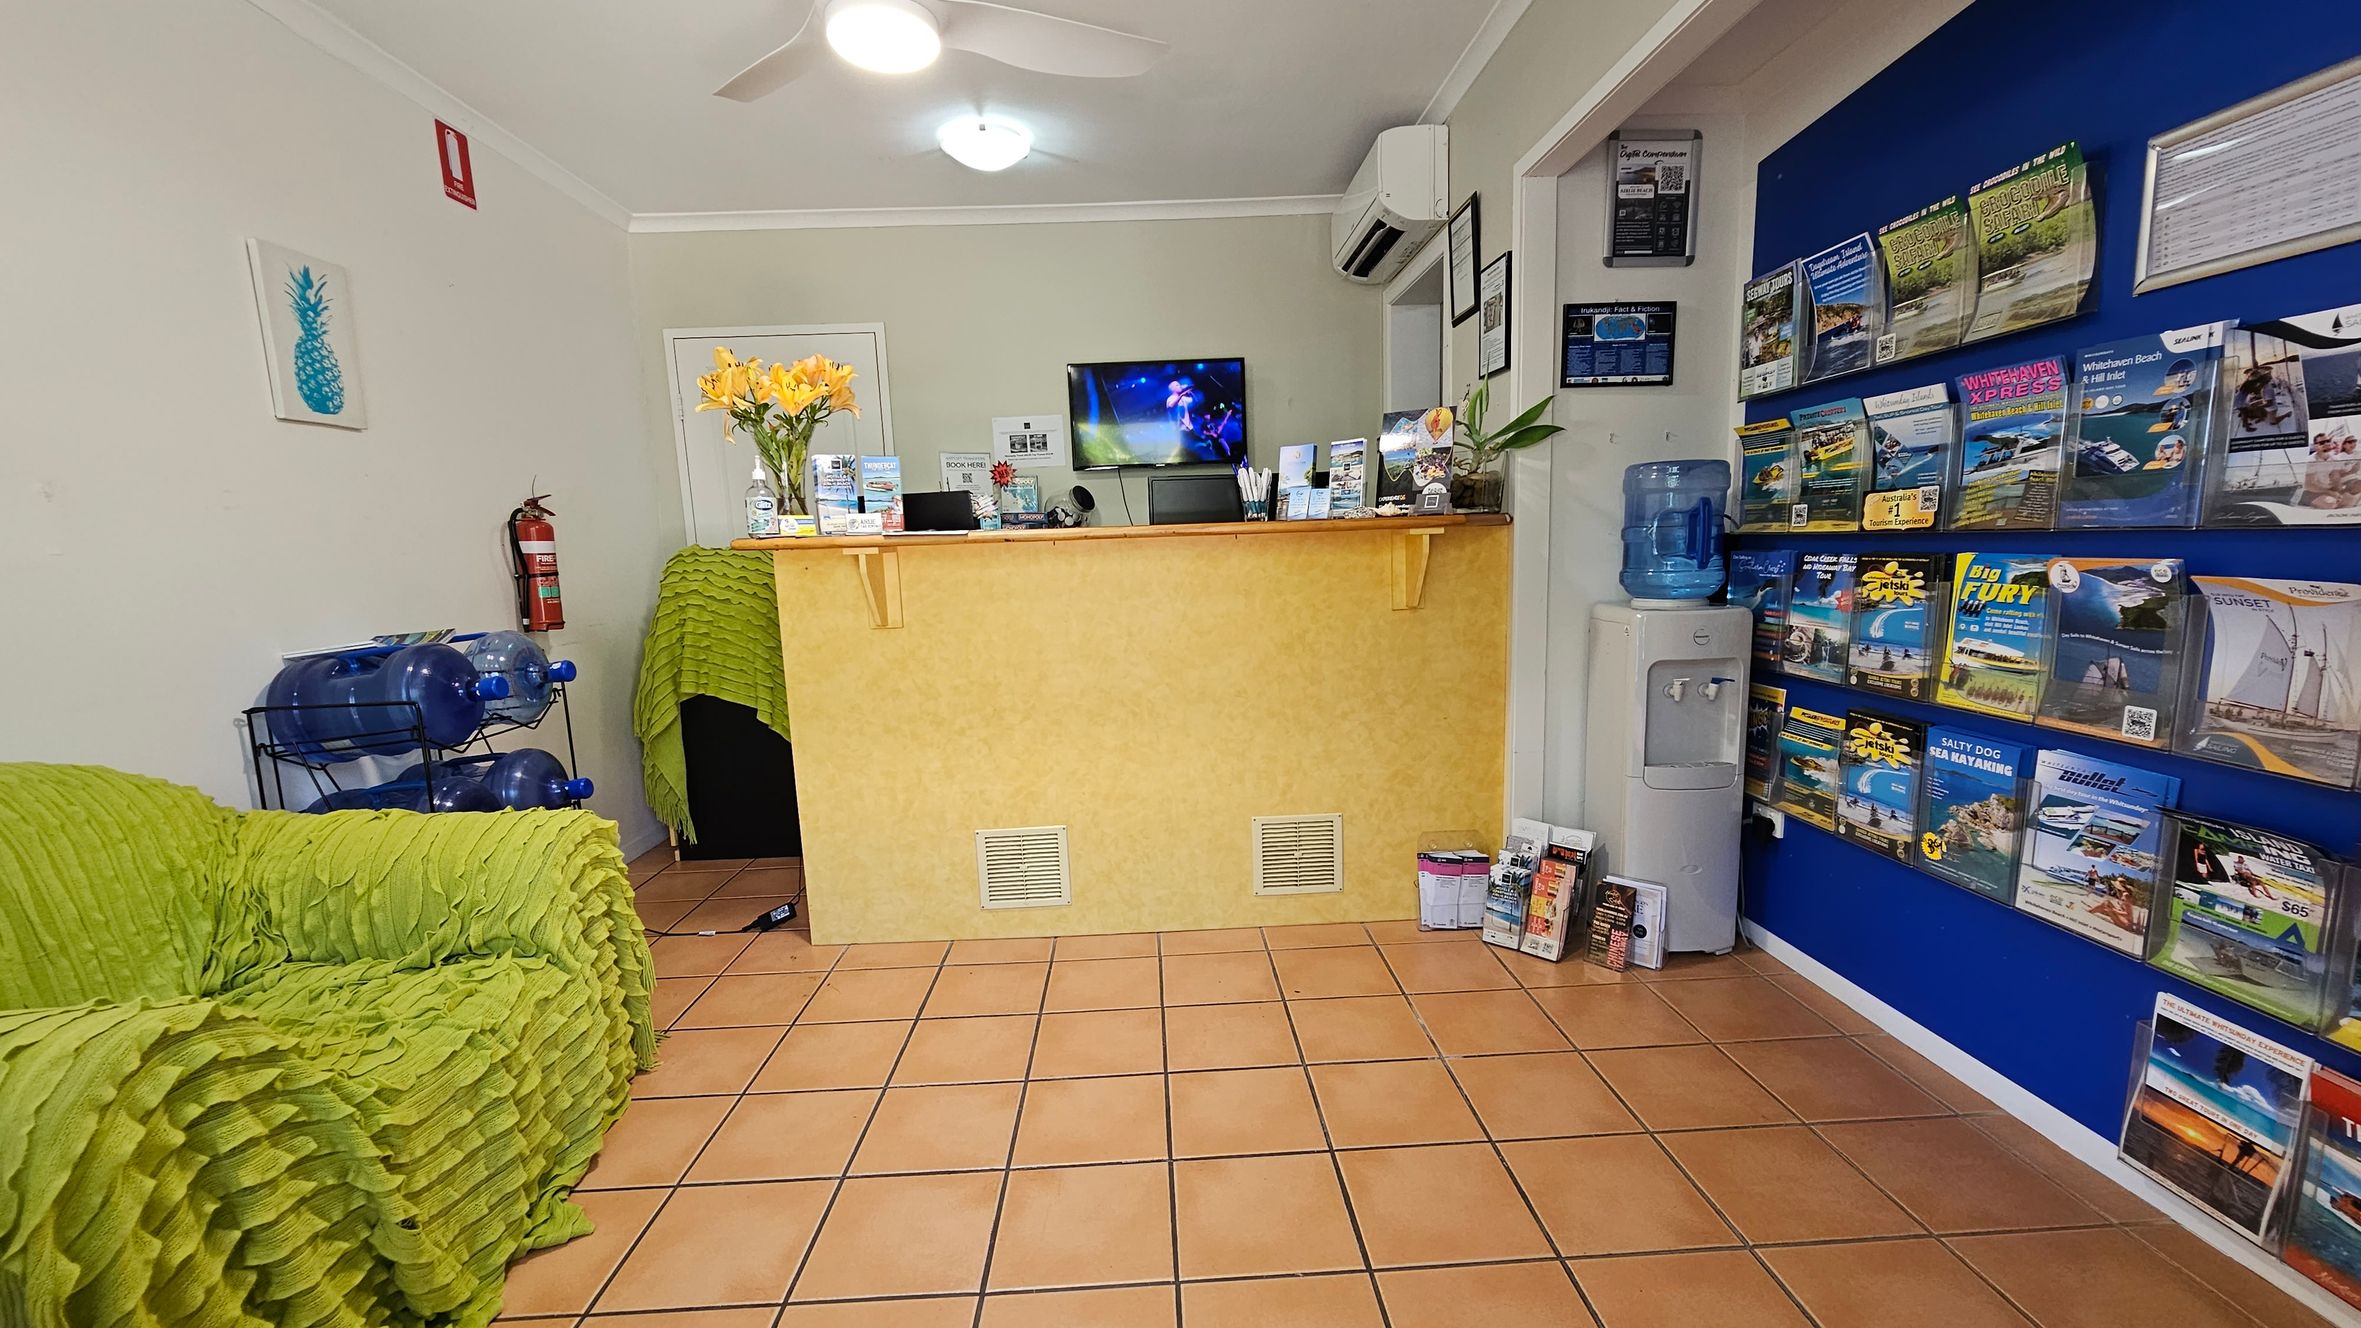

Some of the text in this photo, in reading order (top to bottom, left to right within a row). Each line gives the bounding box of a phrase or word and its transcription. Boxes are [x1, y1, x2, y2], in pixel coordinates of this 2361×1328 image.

[1620, 150, 1687, 160] Digital Compendium
[2033, 154, 2047, 166] THE
[1980, 163, 2070, 217] CROCODILE
[1983, 199, 2040, 236] SAFARI
[1889, 210, 1961, 254] CROCODILE
[1836, 251, 1869, 268] Adventure
[1841, 241, 1863, 258] Island
[1893, 238, 1939, 269] SAFARI
[1746, 271, 1793, 301] SEGWAY TOURS
[2082, 351, 2162, 373] Whitehaven Beach
[1962, 360, 2059, 391] WHITEHAVEN
[2081, 370, 2126, 384] & Hill Inlet
[1970, 377, 2062, 405] XPRESS
[1881, 492, 1917, 503] Australia's
[1888, 502, 1901, 518] #1
[1869, 516, 1929, 527] Tourism Experience
[1816, 571, 1831, 579] TOUR
[1842, 564, 1856, 572] BAY
[1969, 564, 2001, 582] Big
[1879, 579, 1909, 591] jetski
[1960, 581, 2039, 605] FURY
[2214, 597, 2271, 608] SUNSET
[1865, 739, 1895, 753] jetski
[1942, 737, 2001, 759] SALTY DOG
[1929, 746, 2013, 777] SEA KAYAKING
[2228, 827, 2304, 855] ISLAND
[2259, 853, 2316, 874] WATER TAXI
[1607, 928, 1621, 967] CHINESE
[2162, 999, 2305, 1066] THE ULTIMATE WHITSUNDAY EXPERIENCE
[2164, 1086, 2177, 1096] TWO
[2178, 1094, 2199, 1107] GREAT
[2200, 1104, 2220, 1119] TOURS
[2244, 1128, 2259, 1139] DAY
